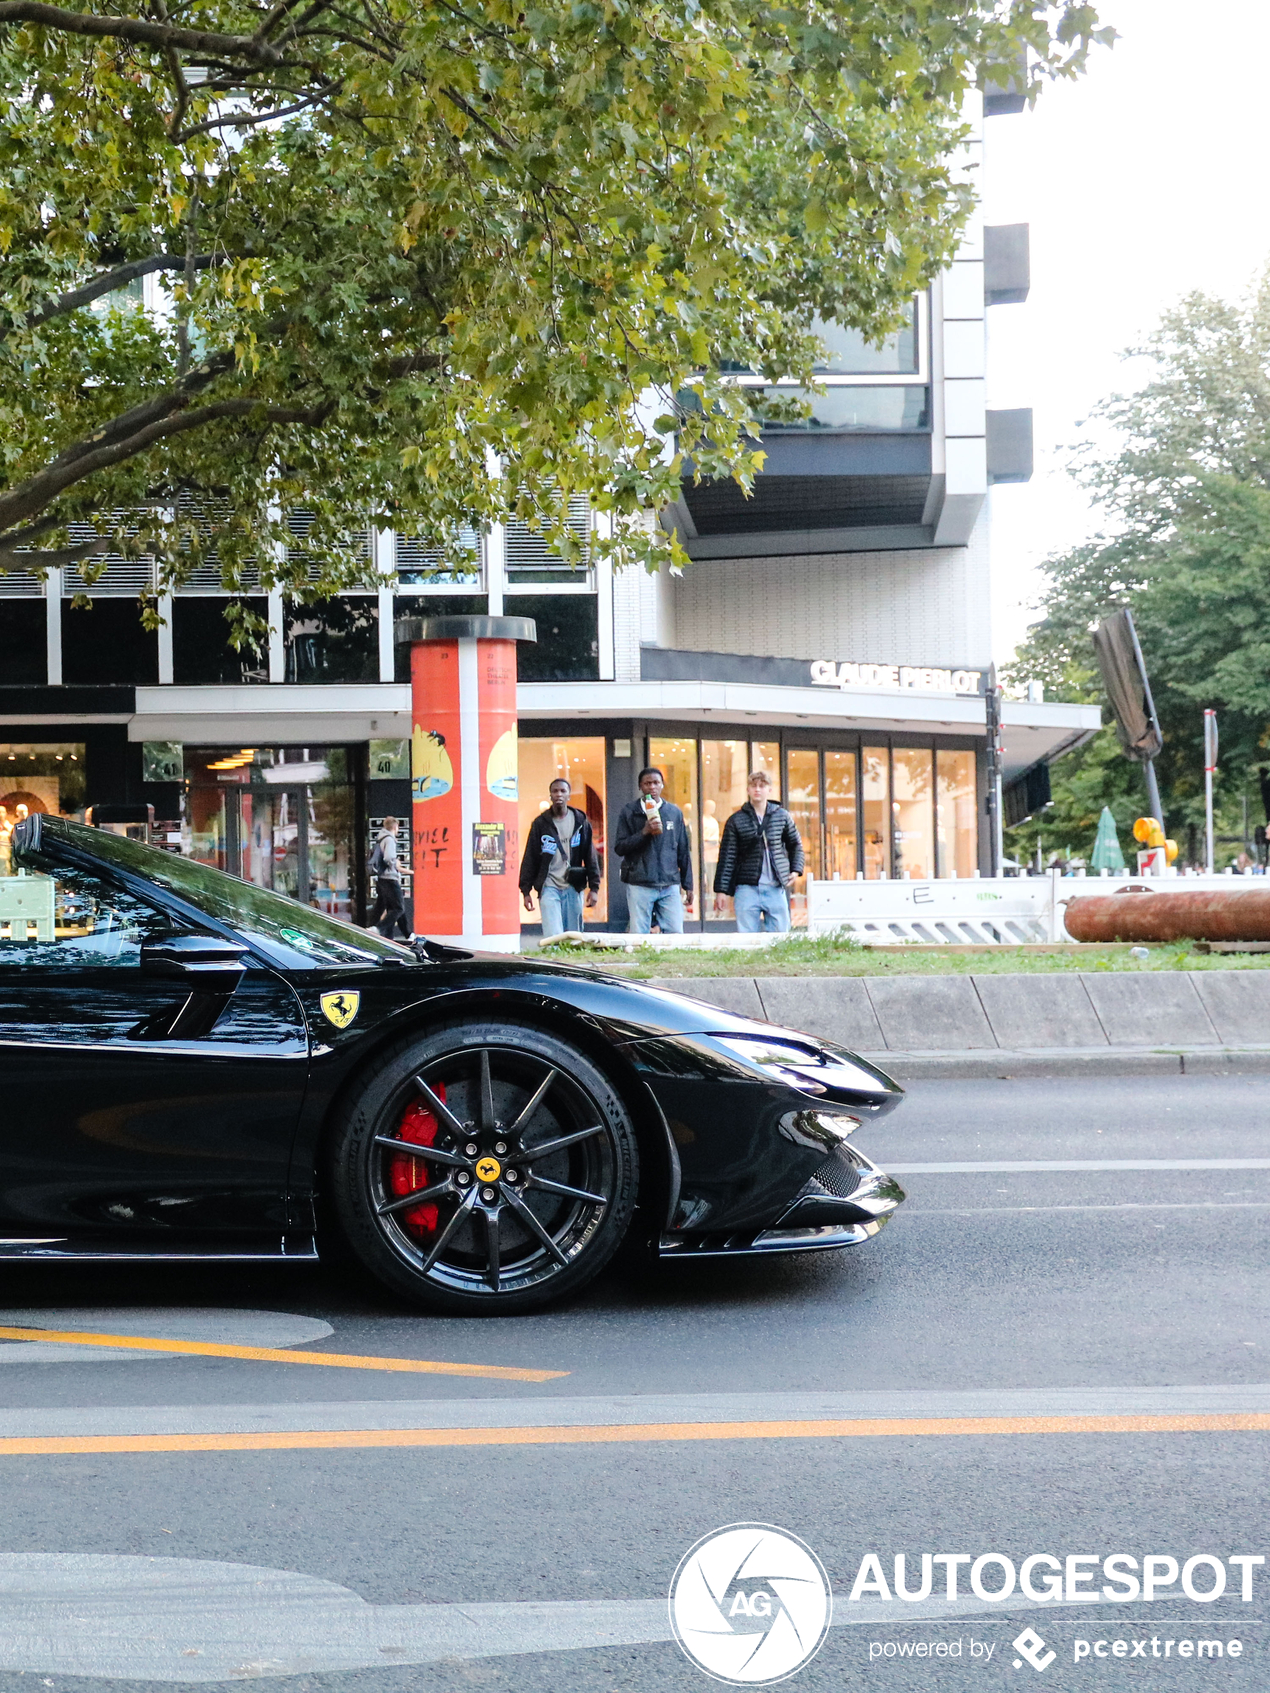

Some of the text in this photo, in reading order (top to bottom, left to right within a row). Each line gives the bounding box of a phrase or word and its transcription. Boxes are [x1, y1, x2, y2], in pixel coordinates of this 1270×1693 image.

[810, 660, 981, 691] CLAUDE PIERLOT
[378, 761, 390, 773] 40
[619, 1138, 632, 1200] MICHELIN
